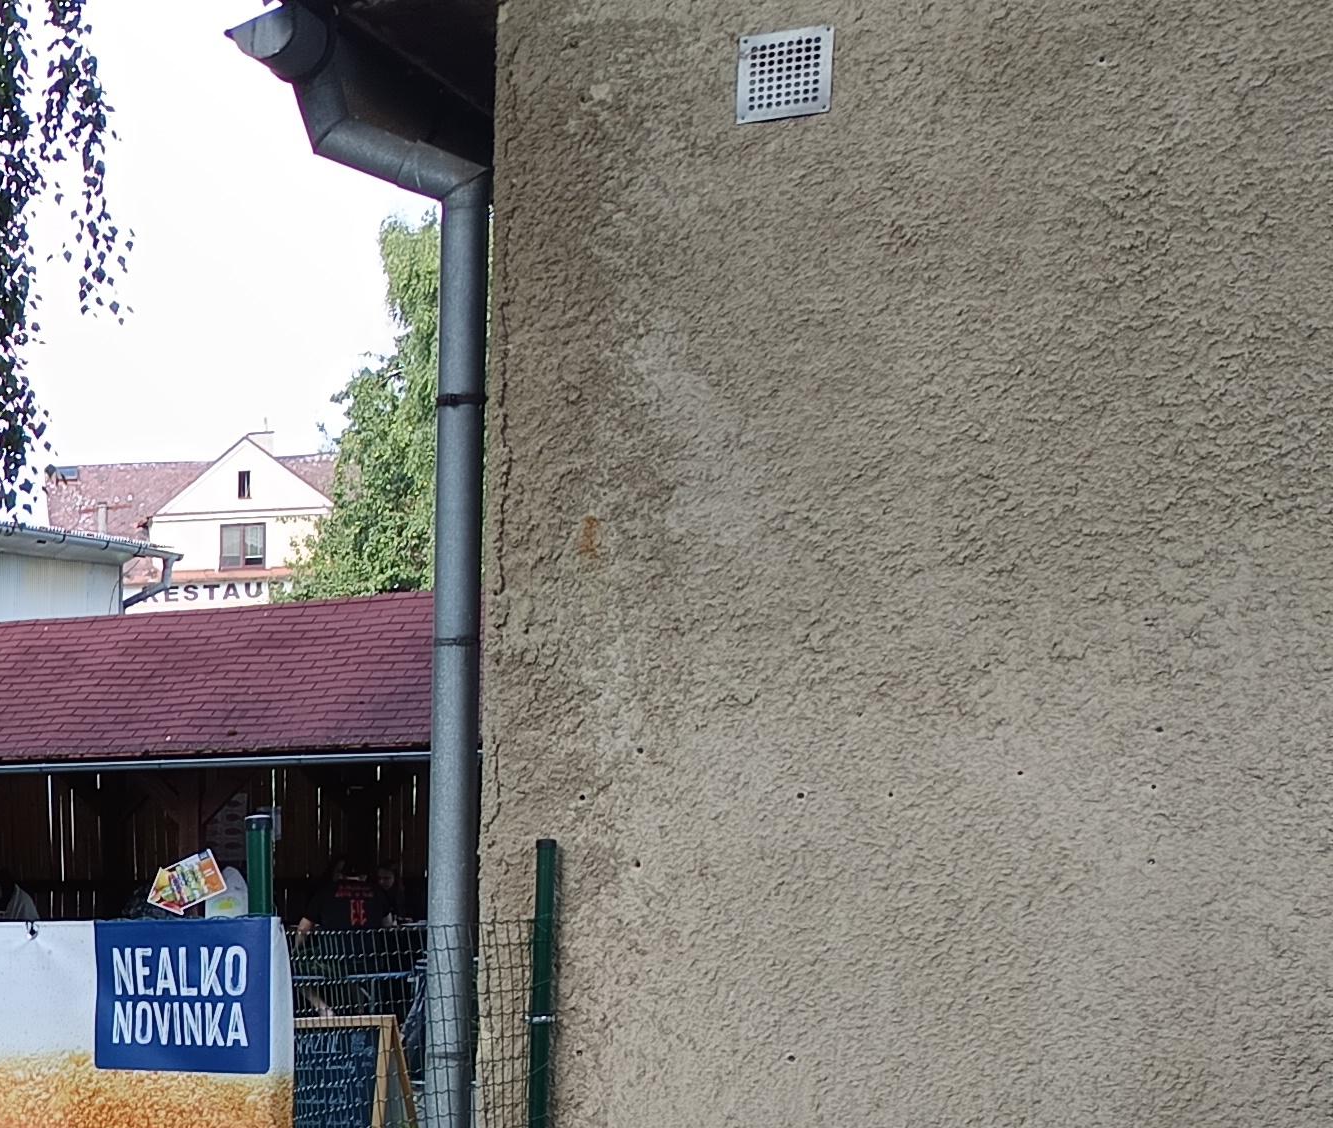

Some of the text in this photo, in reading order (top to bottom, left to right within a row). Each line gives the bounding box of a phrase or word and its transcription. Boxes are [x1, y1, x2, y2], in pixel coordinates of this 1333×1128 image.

[141, 581, 264, 603] RESTAU
[112, 945, 248, 997] NEALKO
[112, 1000, 249, 1047] NOVINKA
